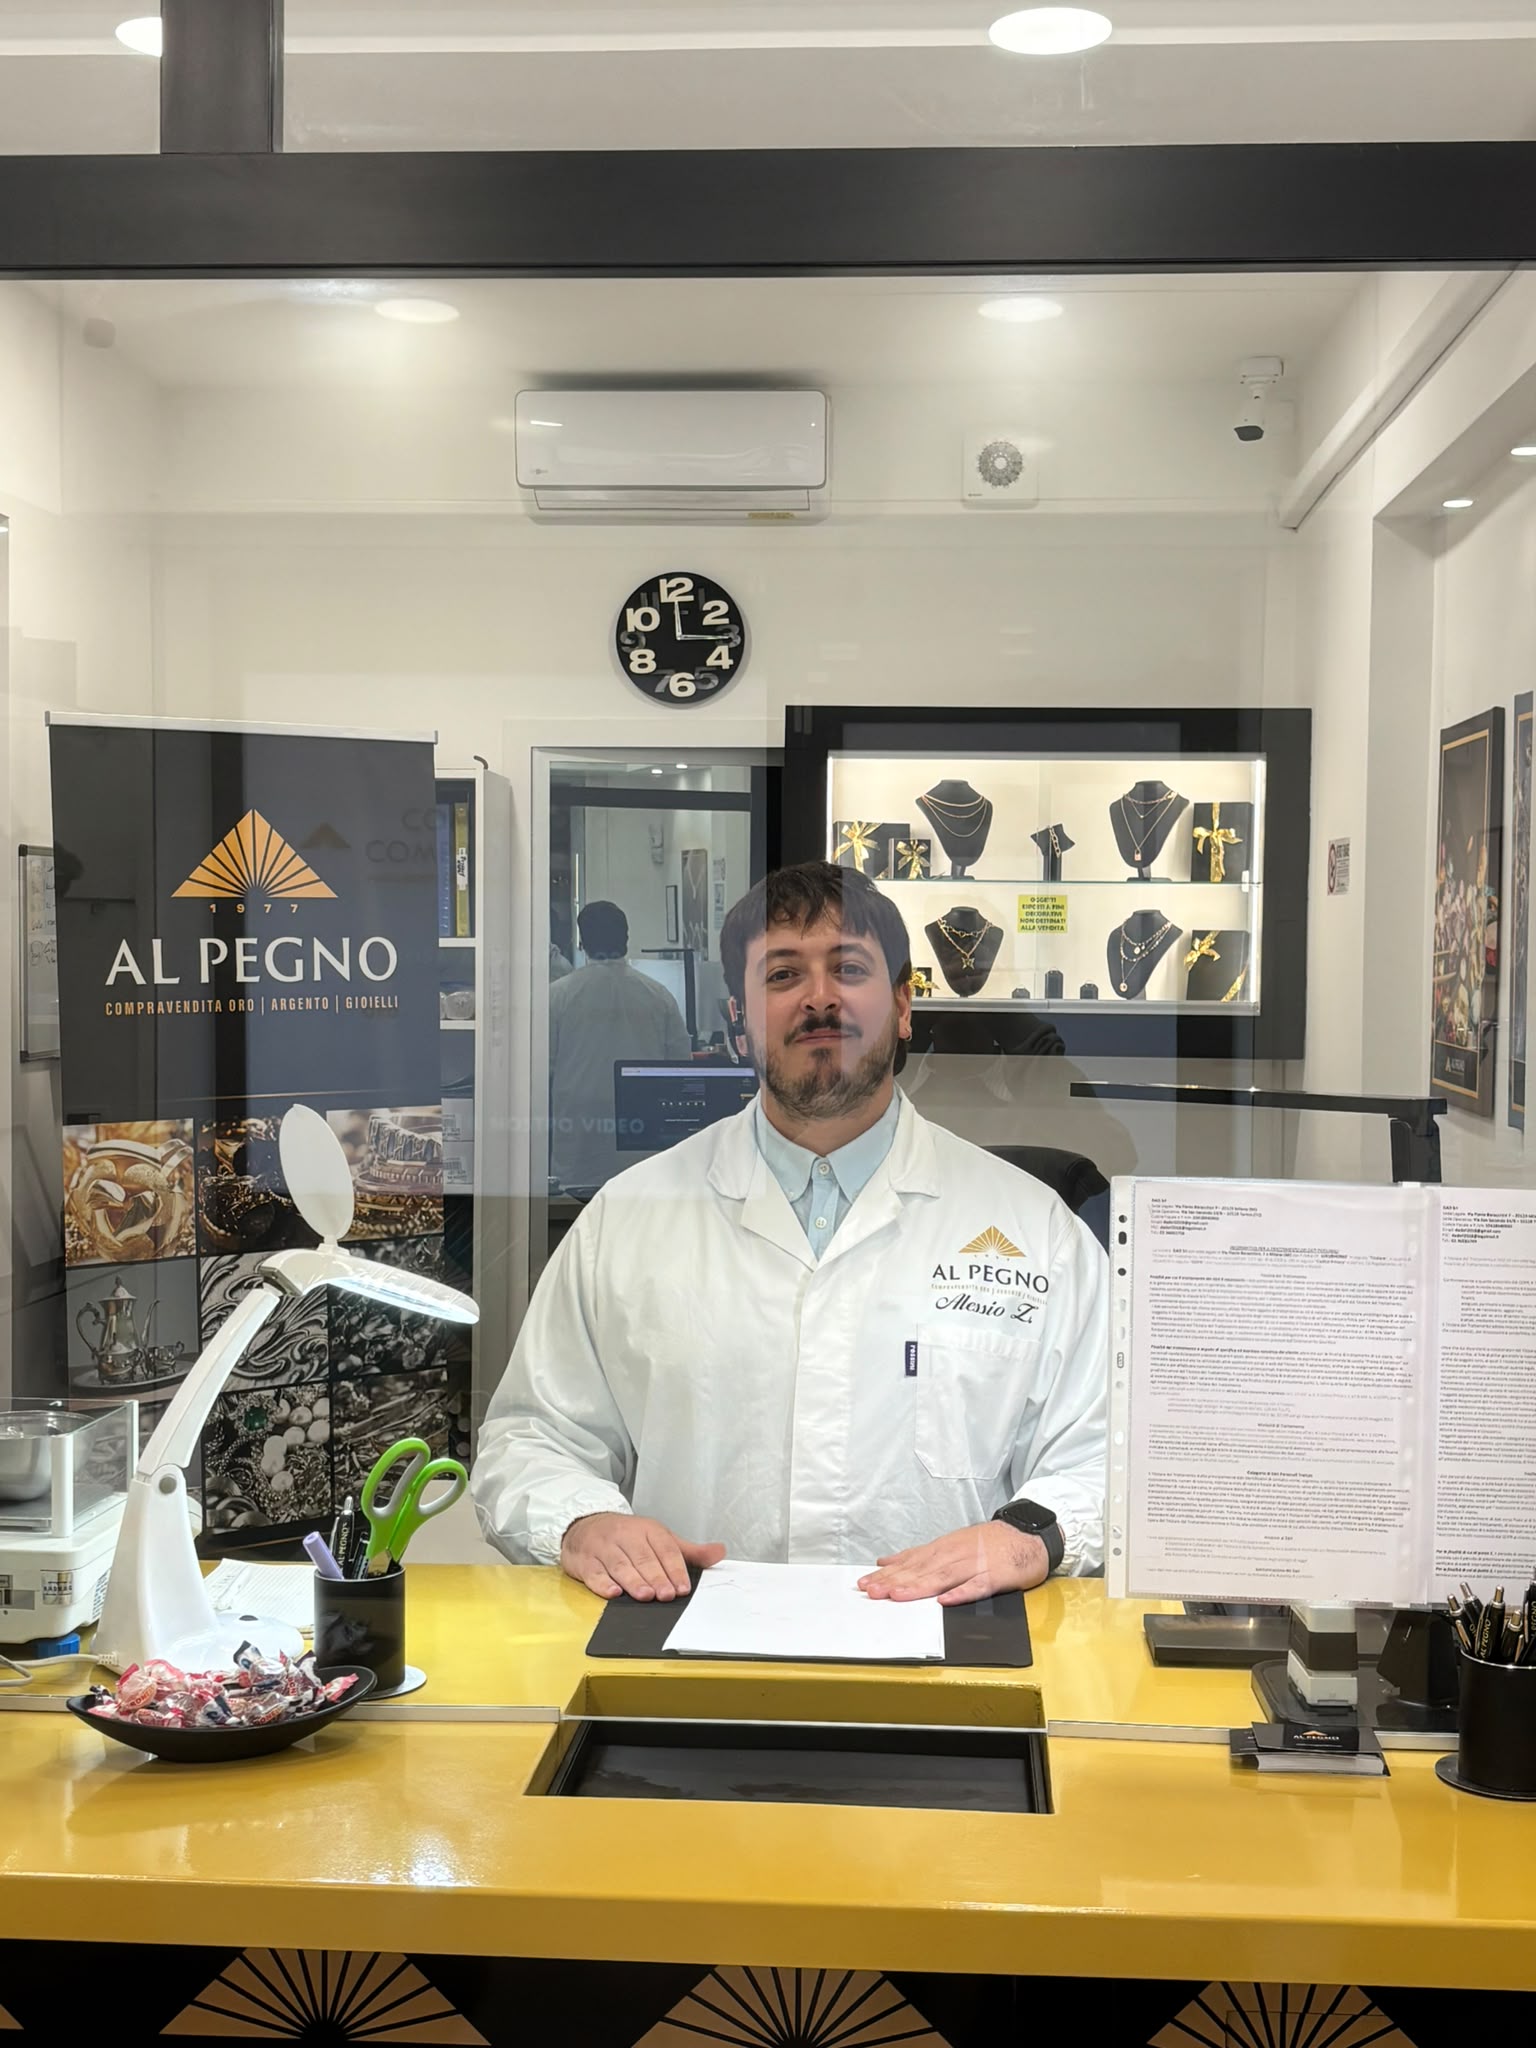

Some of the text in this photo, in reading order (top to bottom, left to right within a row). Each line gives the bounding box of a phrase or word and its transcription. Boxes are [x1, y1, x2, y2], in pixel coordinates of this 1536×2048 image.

[659, 577, 694, 603] 12
[626, 607, 660, 632] 10
[702, 600, 730, 626] 2
[629, 649, 657, 674] 8
[706, 645, 734, 670] 4
[669, 672, 697, 698] 6
[104, 936, 398, 986] AL PEGNO
[105, 995, 399, 1017] COMPRAVENDITA ORO ARGENTO GIOIELLI
[932, 1264, 1050, 1294] AL PEGNO
[935, 1293, 1006, 1318] Alessio
